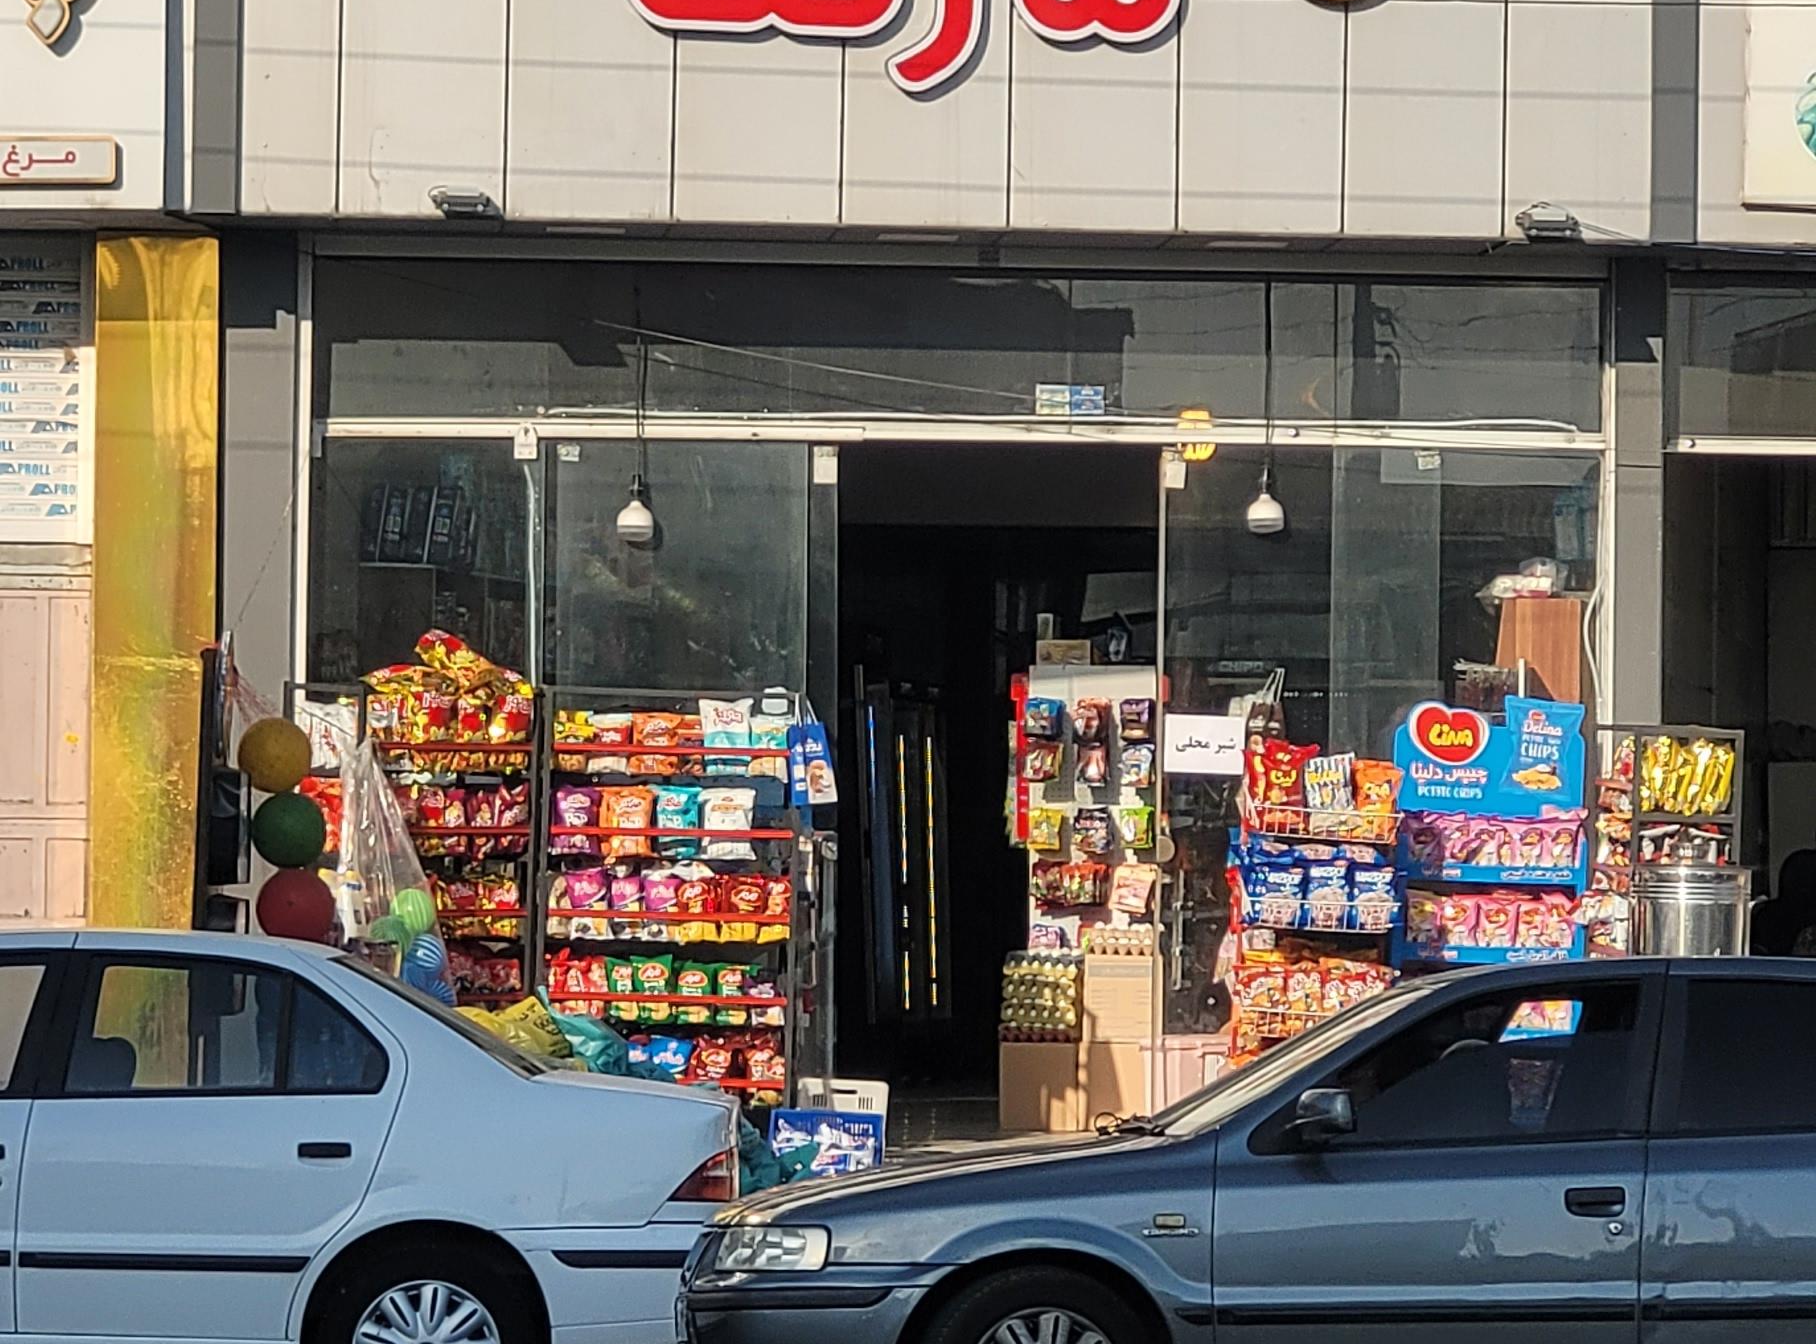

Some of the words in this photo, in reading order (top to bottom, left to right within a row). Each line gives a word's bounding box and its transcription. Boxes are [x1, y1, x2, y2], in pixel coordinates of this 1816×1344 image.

[2, 144, 76, 178] مرغ
[1175, 736, 1211, 752] محلی
[1214, 738, 1237, 754] شیر
[1520, 742, 1560, 760] CHIPS
